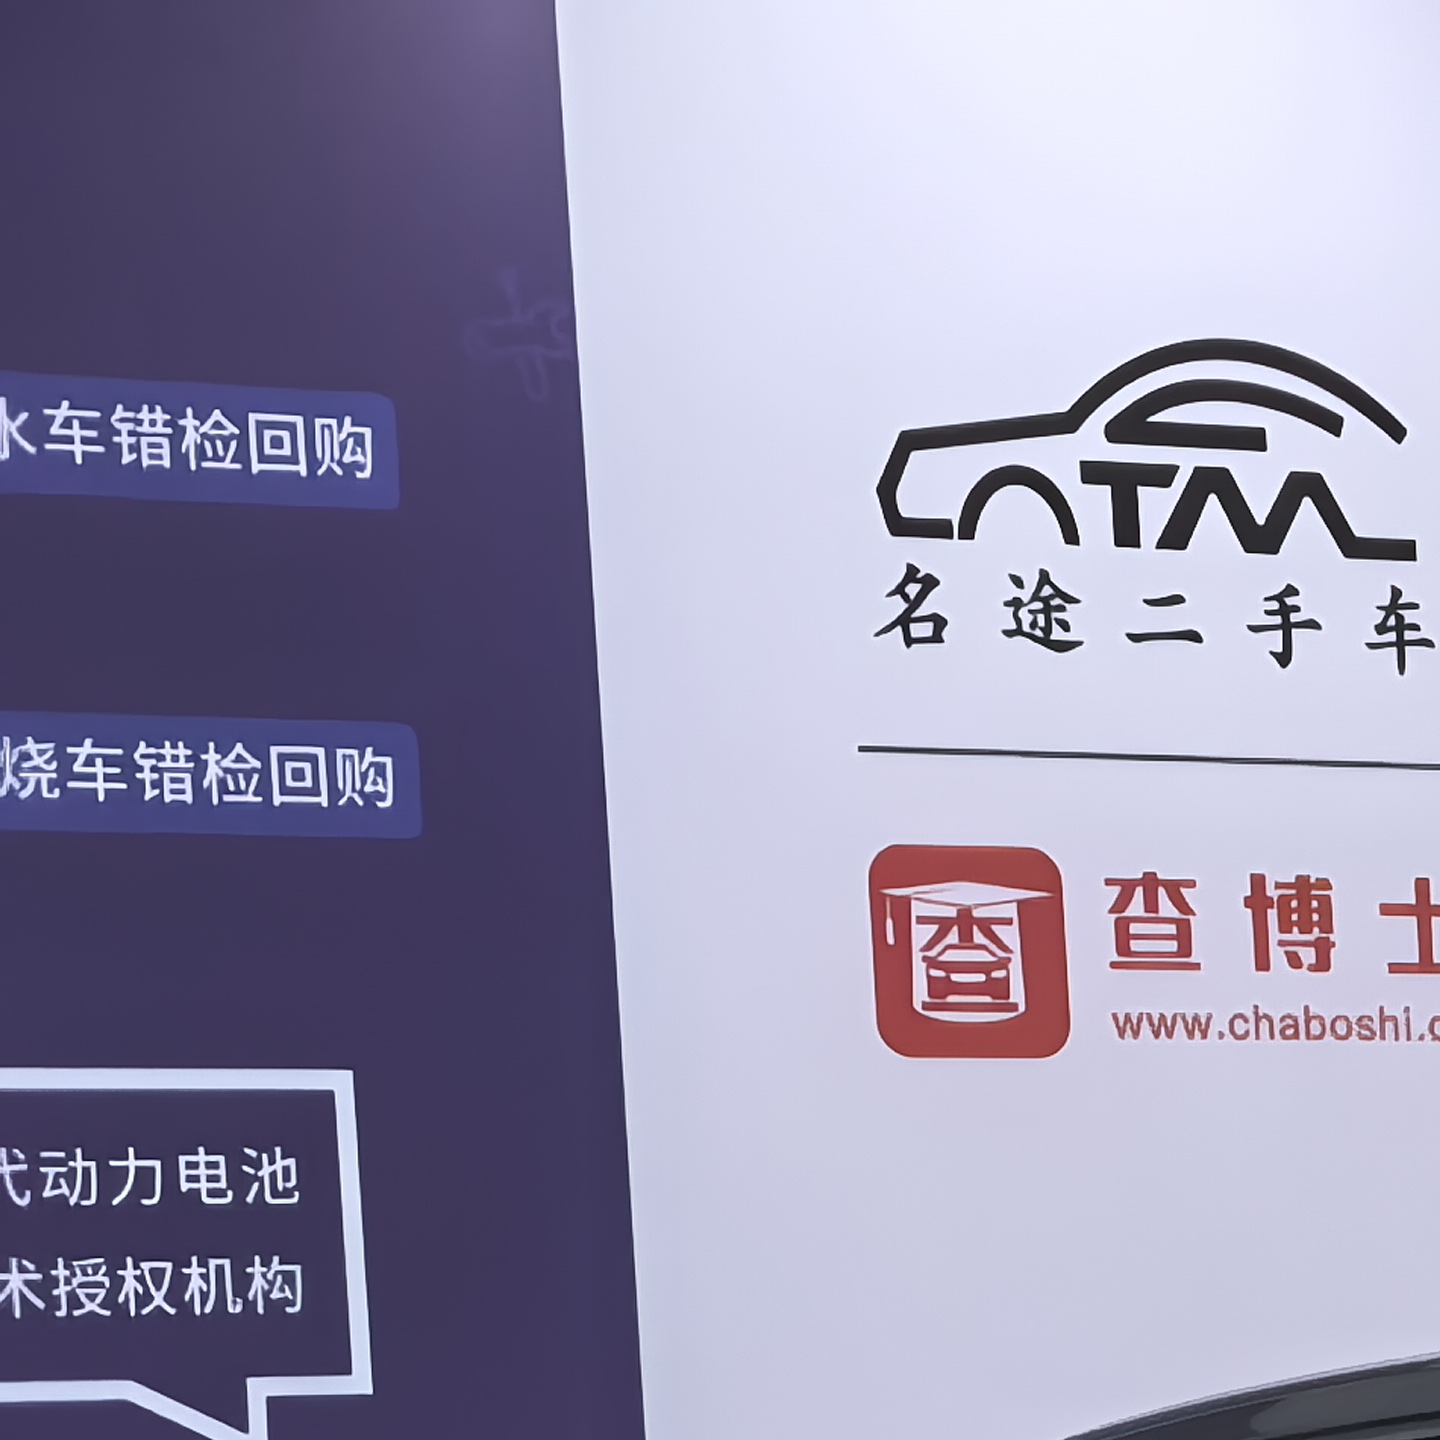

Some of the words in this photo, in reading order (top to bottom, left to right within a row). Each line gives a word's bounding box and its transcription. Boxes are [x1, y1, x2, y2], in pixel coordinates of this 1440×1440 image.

[874, 562, 1436, 676] 名途二手车
[0, 735, 394, 808] 烧车错检回购
[0, 1254, 302, 1319] 术授权机构
